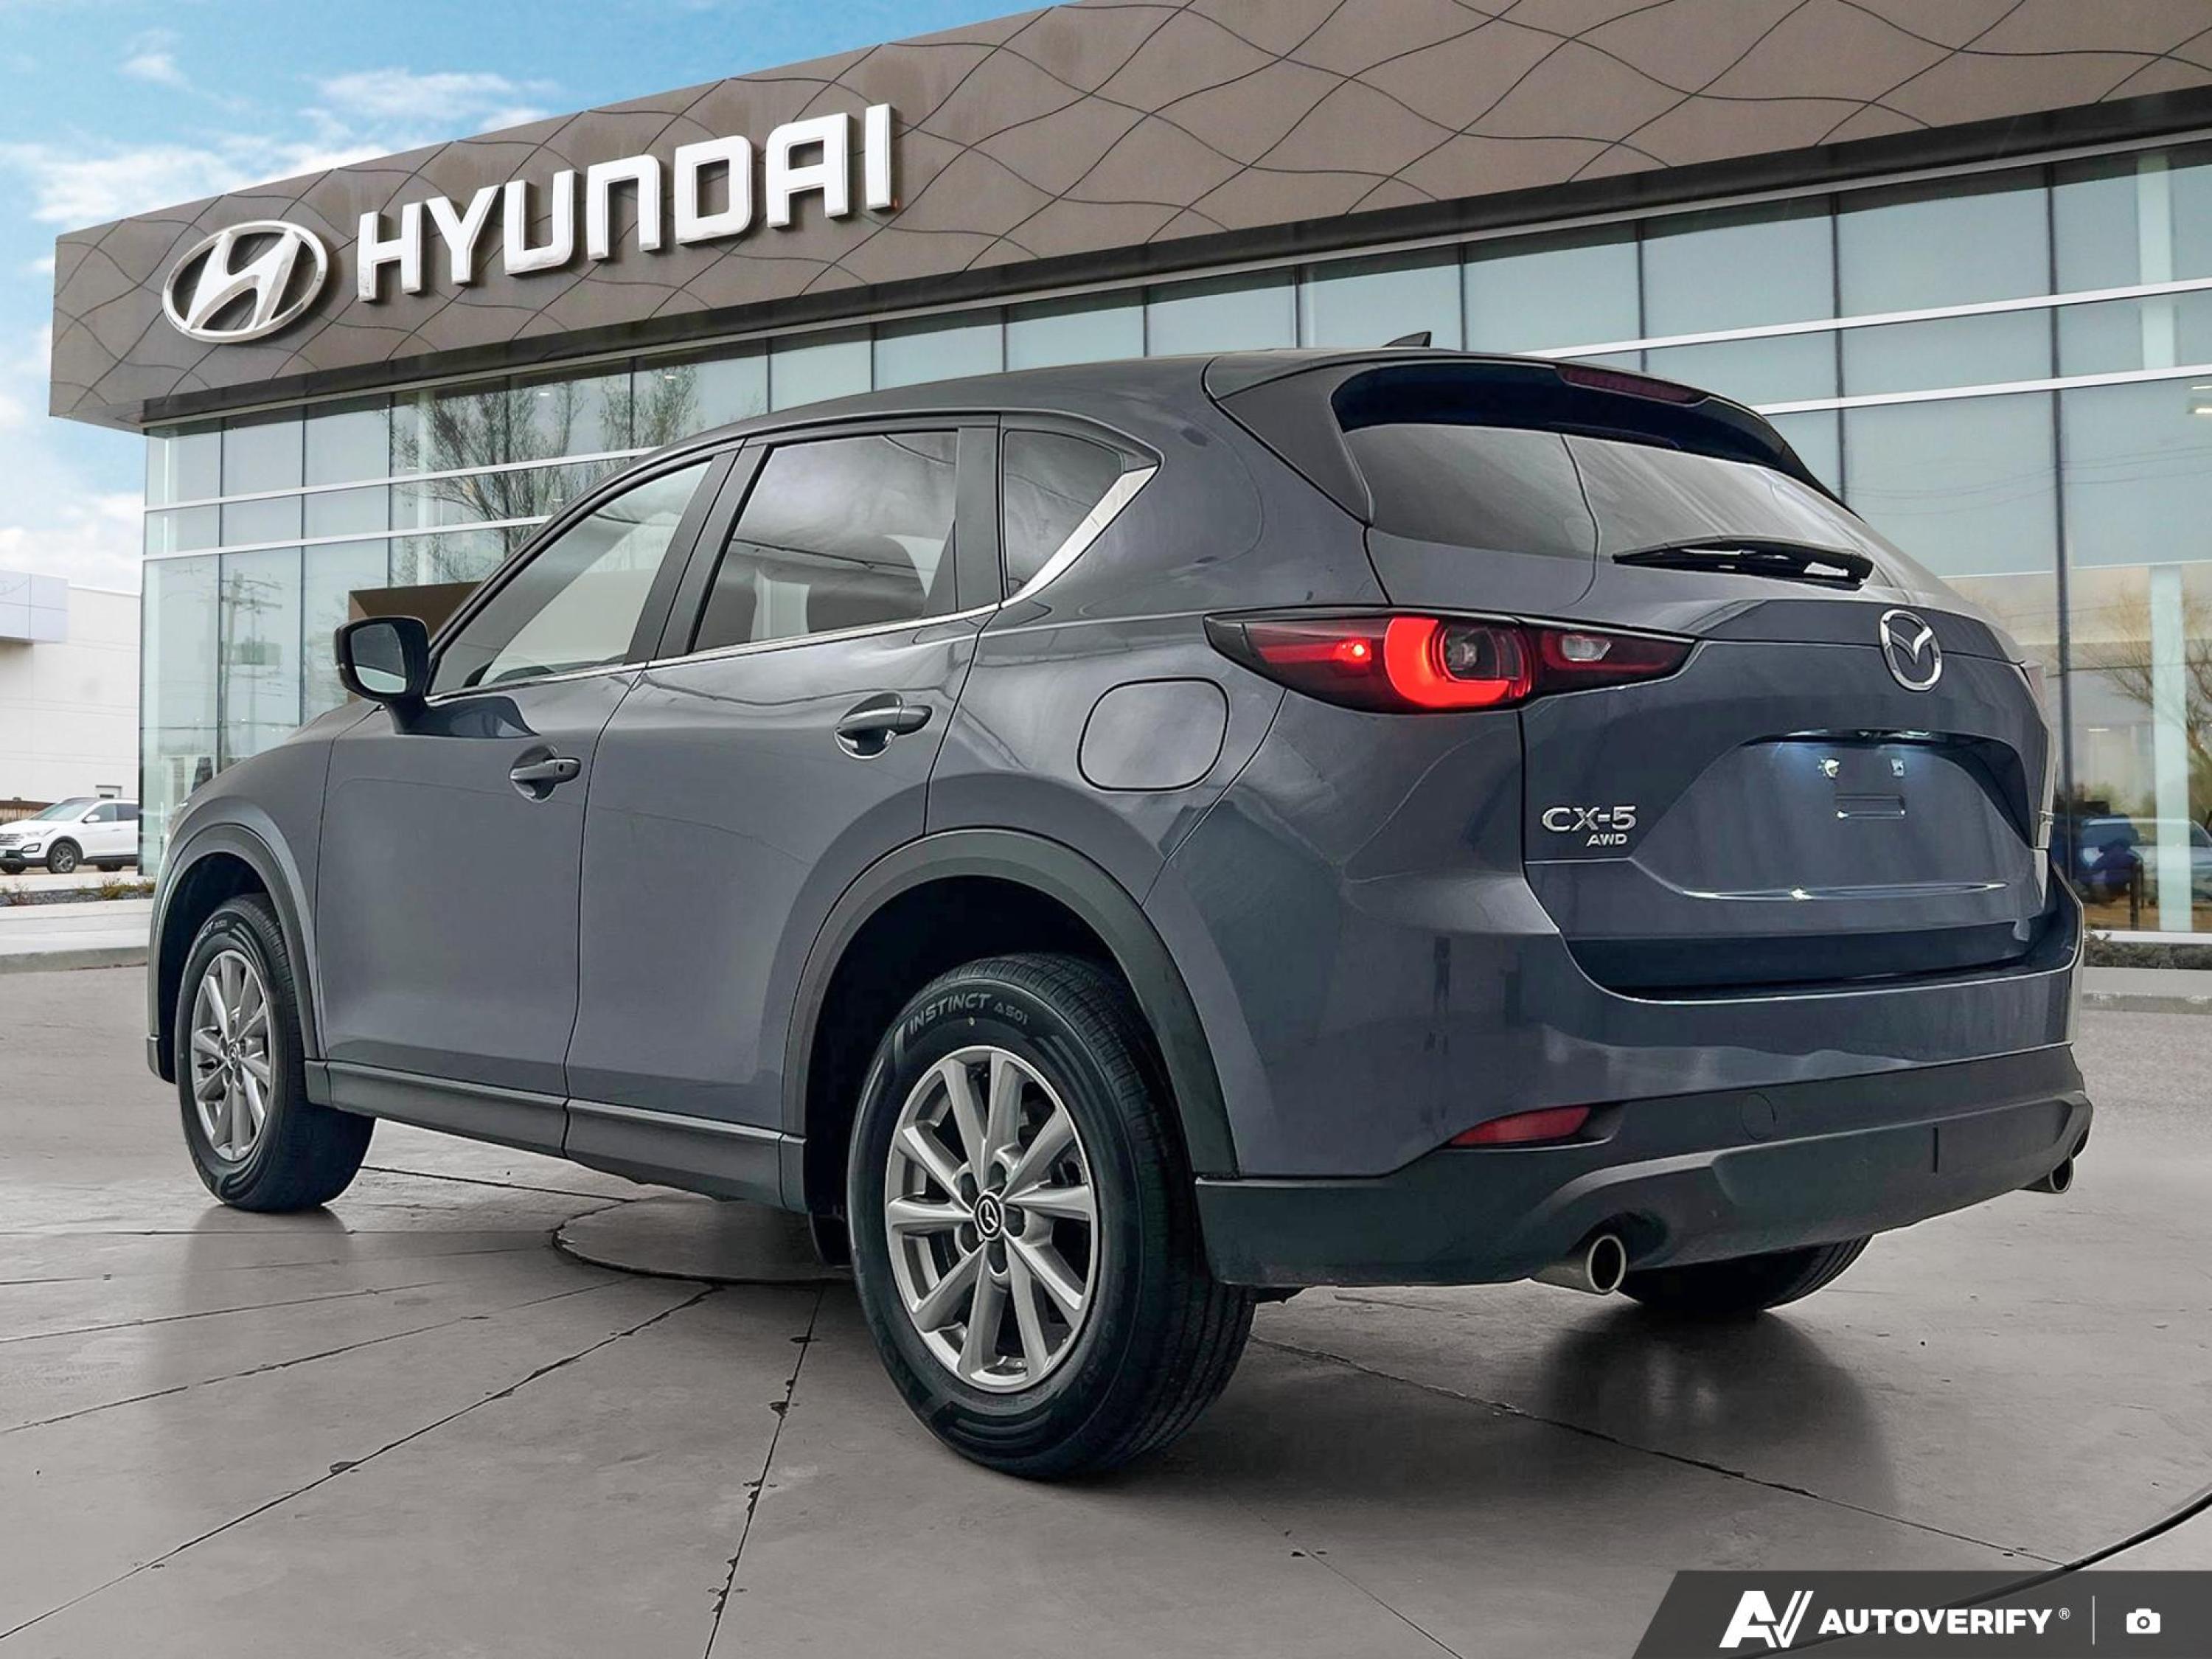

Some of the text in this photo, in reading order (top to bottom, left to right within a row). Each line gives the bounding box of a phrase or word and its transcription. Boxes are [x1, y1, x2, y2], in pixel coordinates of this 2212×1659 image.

[358, 103, 893, 302] HYUNDAI
[1542, 806, 1637, 832] CX-5
[1587, 834, 1628, 846] AWD
[909, 993, 992, 1034] INSTINCT
